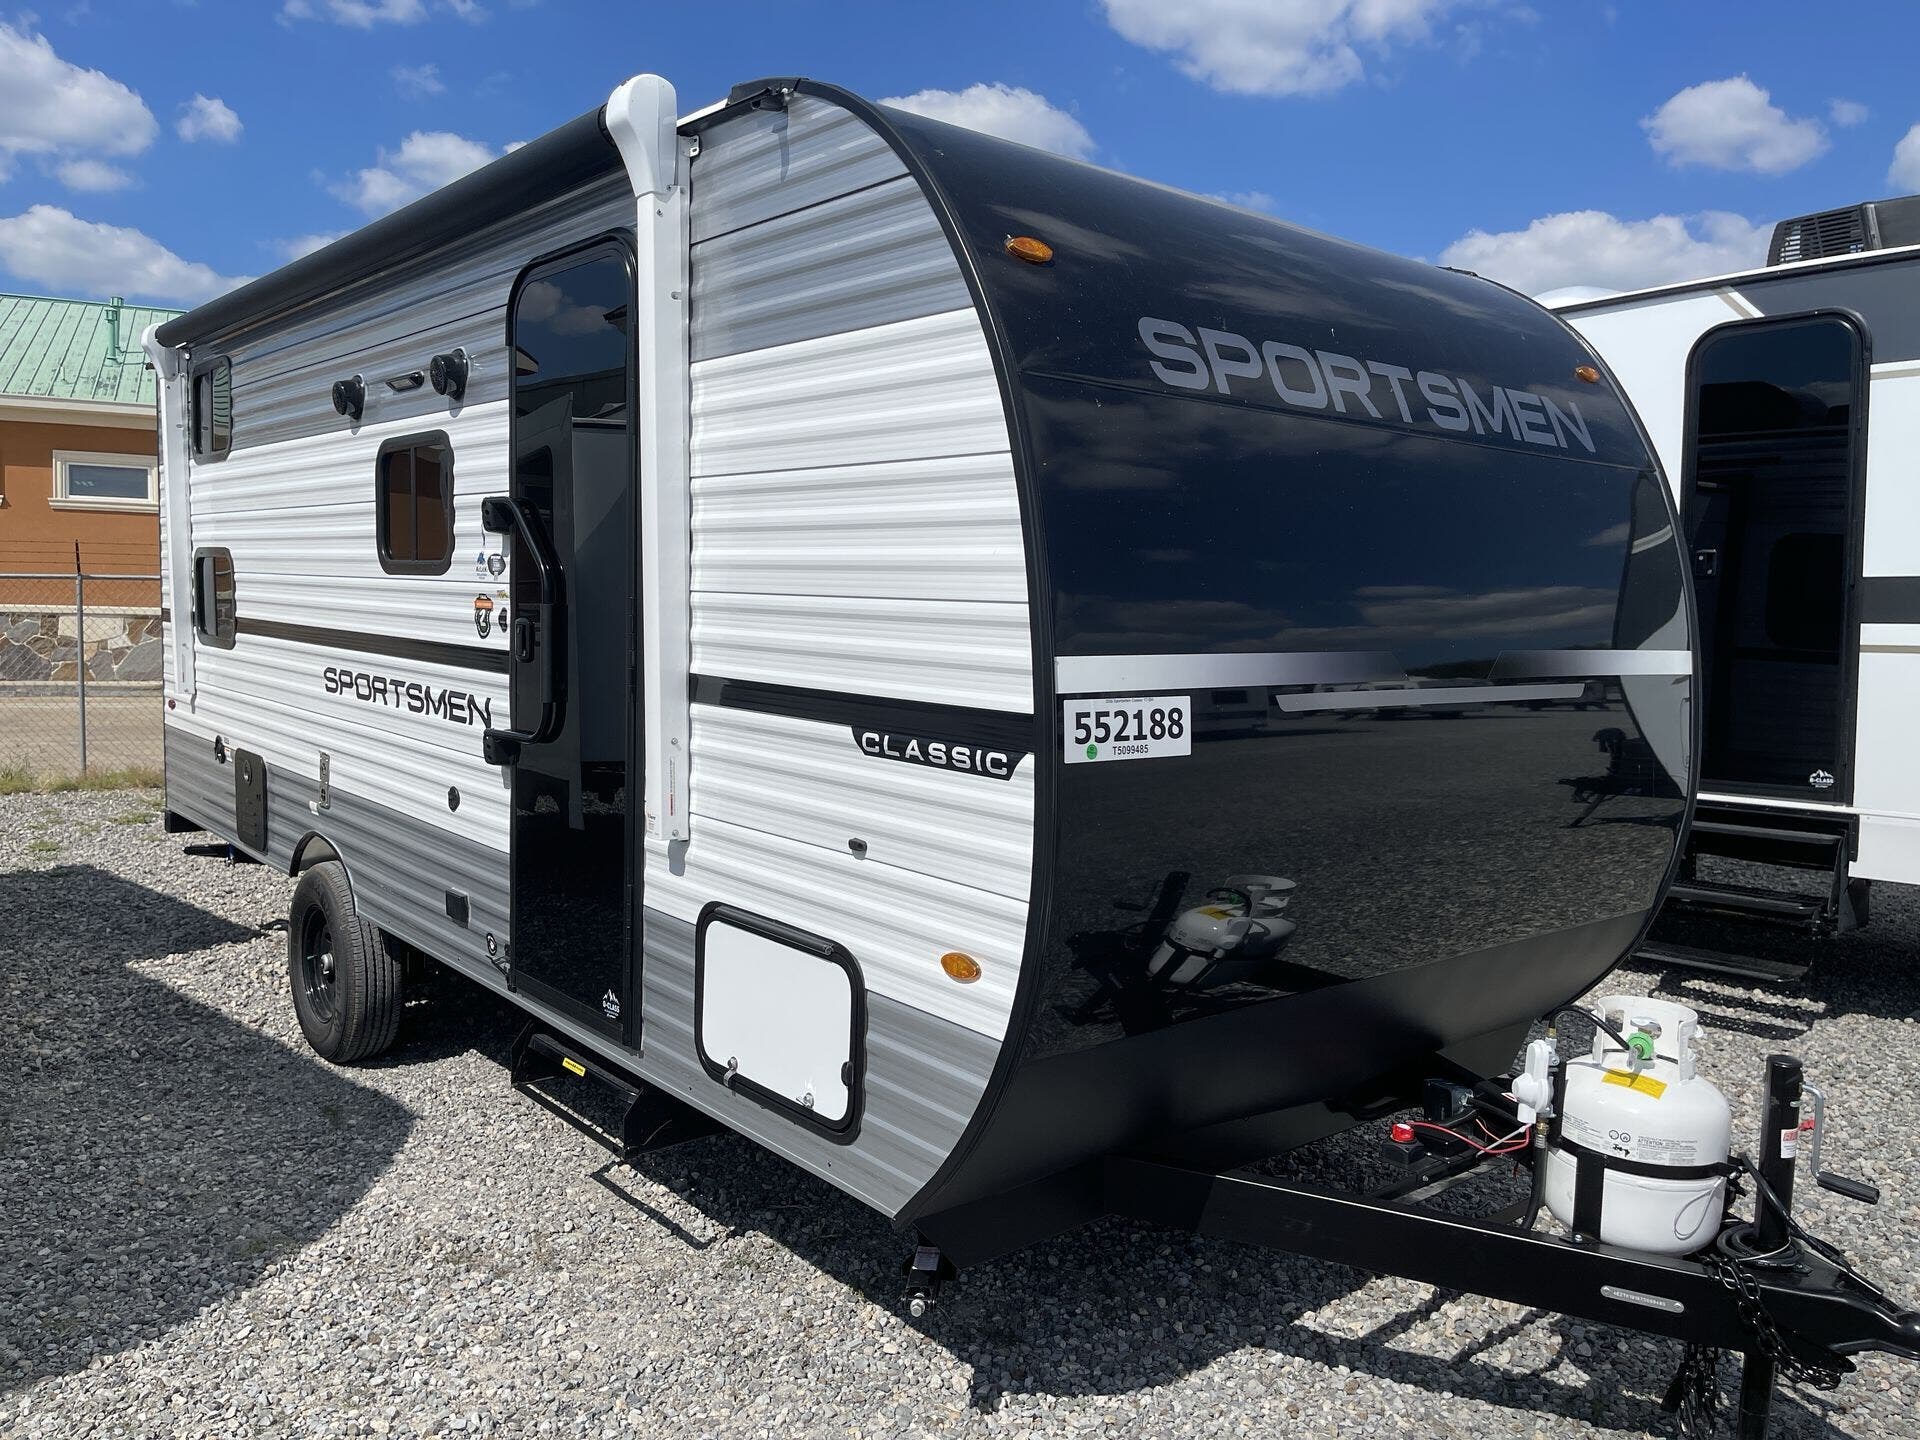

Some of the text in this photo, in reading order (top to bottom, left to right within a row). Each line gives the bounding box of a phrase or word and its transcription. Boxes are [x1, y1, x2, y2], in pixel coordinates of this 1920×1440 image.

[1138, 316, 1595, 452] SPORTSMEN
[323, 666, 492, 728] SPORTSMEN
[1074, 707, 1184, 745] 552188
[861, 731, 1008, 776] CLASSIC
[1112, 744, 1149, 756] T5099485
